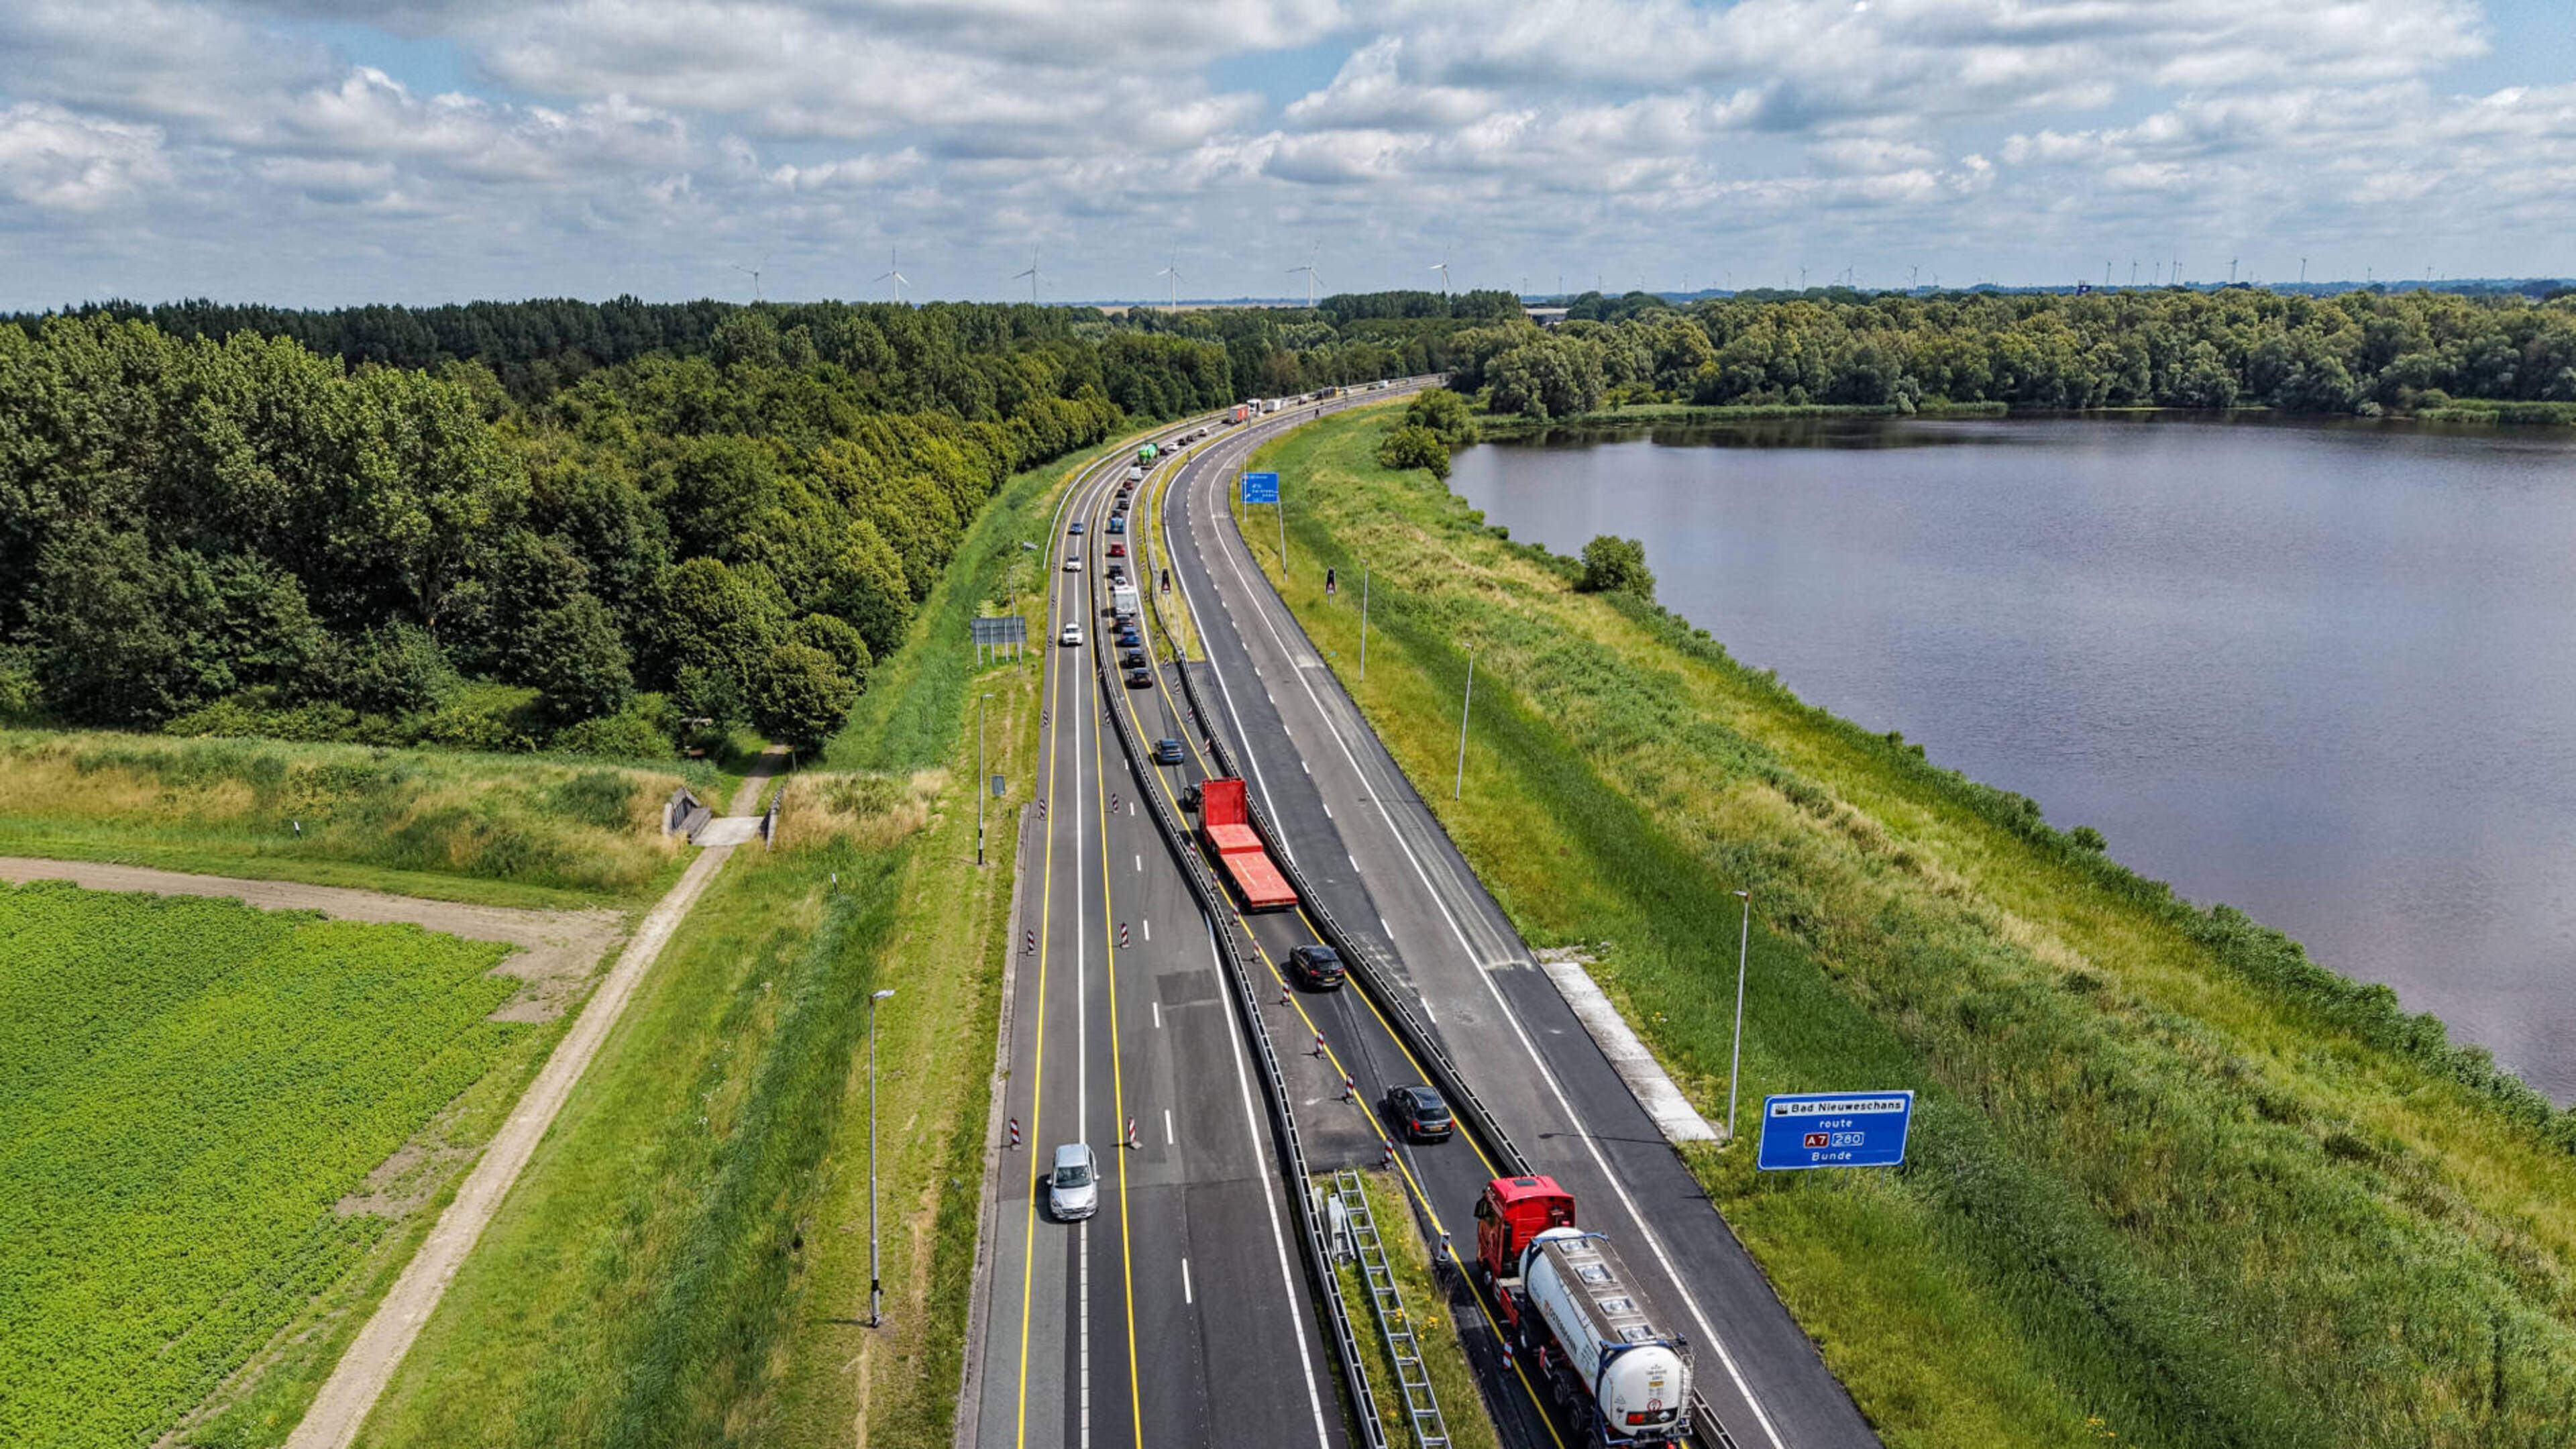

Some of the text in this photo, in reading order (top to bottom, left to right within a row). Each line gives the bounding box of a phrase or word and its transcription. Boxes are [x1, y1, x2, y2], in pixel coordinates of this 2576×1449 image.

[1792, 1102, 1901, 1113] Bad Nieuweschans
[1819, 1119, 1853, 1128] route
[1835, 1134, 1861, 1144] 280
[1811, 1151, 1852, 1161] Bunde
